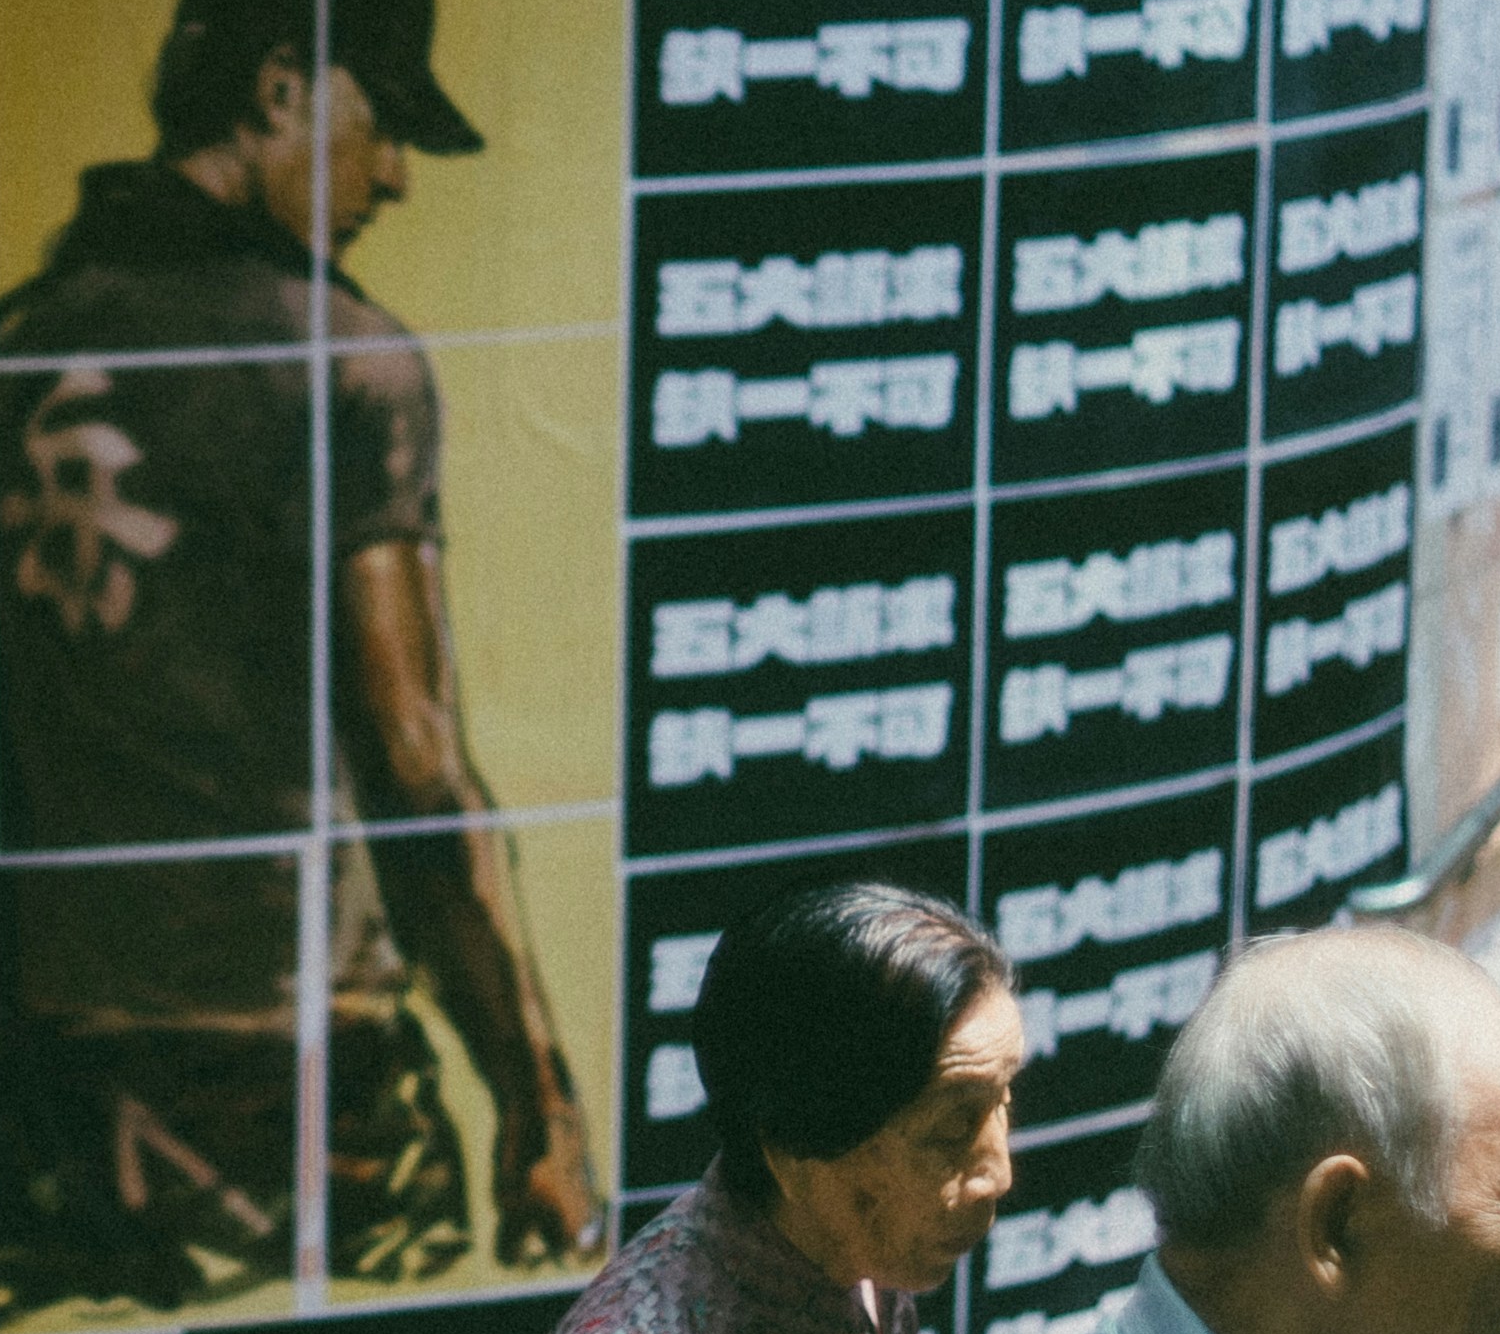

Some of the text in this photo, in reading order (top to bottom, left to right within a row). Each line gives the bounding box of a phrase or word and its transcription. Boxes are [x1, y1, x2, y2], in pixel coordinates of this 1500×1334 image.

[661, 19, 969, 103] 缺一不可
[658, 247, 961, 335] 五大訴求
[654, 355, 957, 445] 缺一不可
[652, 577, 954, 676] 五大訴求
[650, 684, 951, 785] 缺一不可
[985, 1187, 1157, 1291] 五大訴
